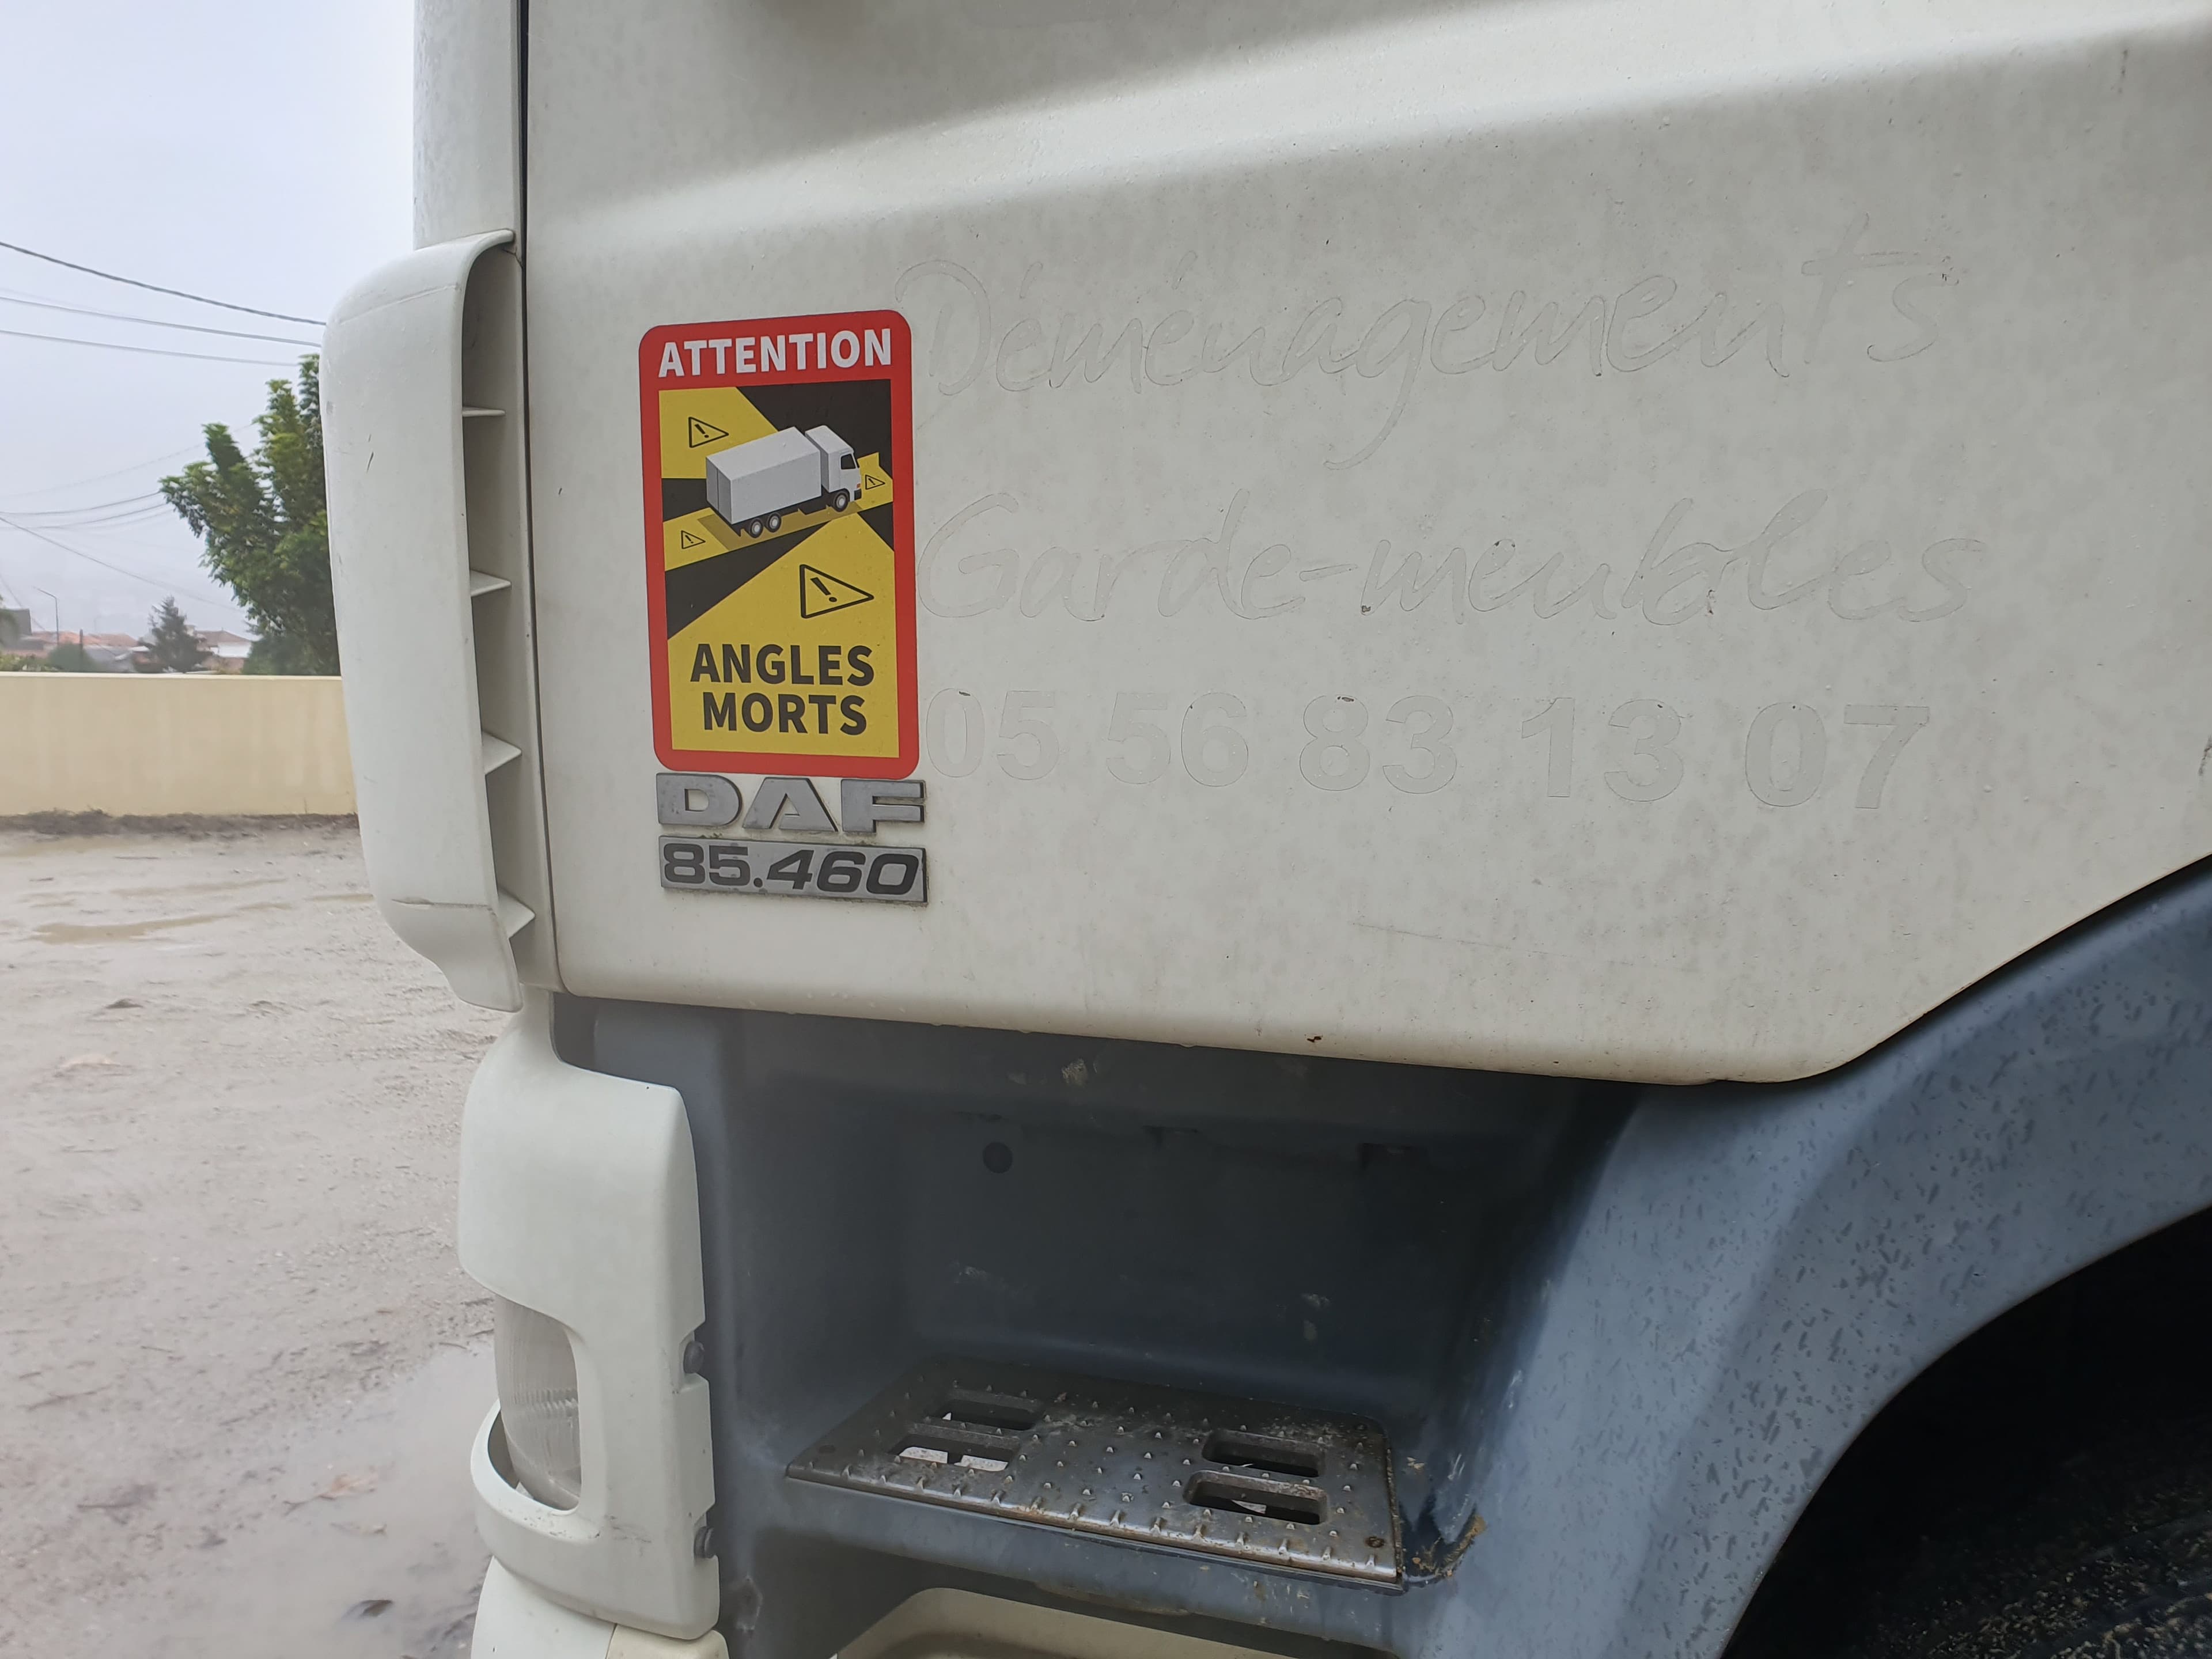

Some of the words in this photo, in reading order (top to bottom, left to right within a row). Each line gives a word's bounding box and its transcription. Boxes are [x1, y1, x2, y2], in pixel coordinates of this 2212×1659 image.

[658, 328, 892, 378] ATTENTION
[918, 488, 1987, 626] Garde-meubles
[690, 643, 875, 687] ANGLES
[703, 692, 868, 736] MORTS
[925, 688, 1060, 781] 05
[1105, 691, 1249, 787] 56
[1299, 694, 1457, 794] 83
[1521, 696, 1685, 802] 13
[1745, 701, 1931, 809] 07
[656, 772, 927, 834] DAF
[663, 843, 920, 895] 85.460
